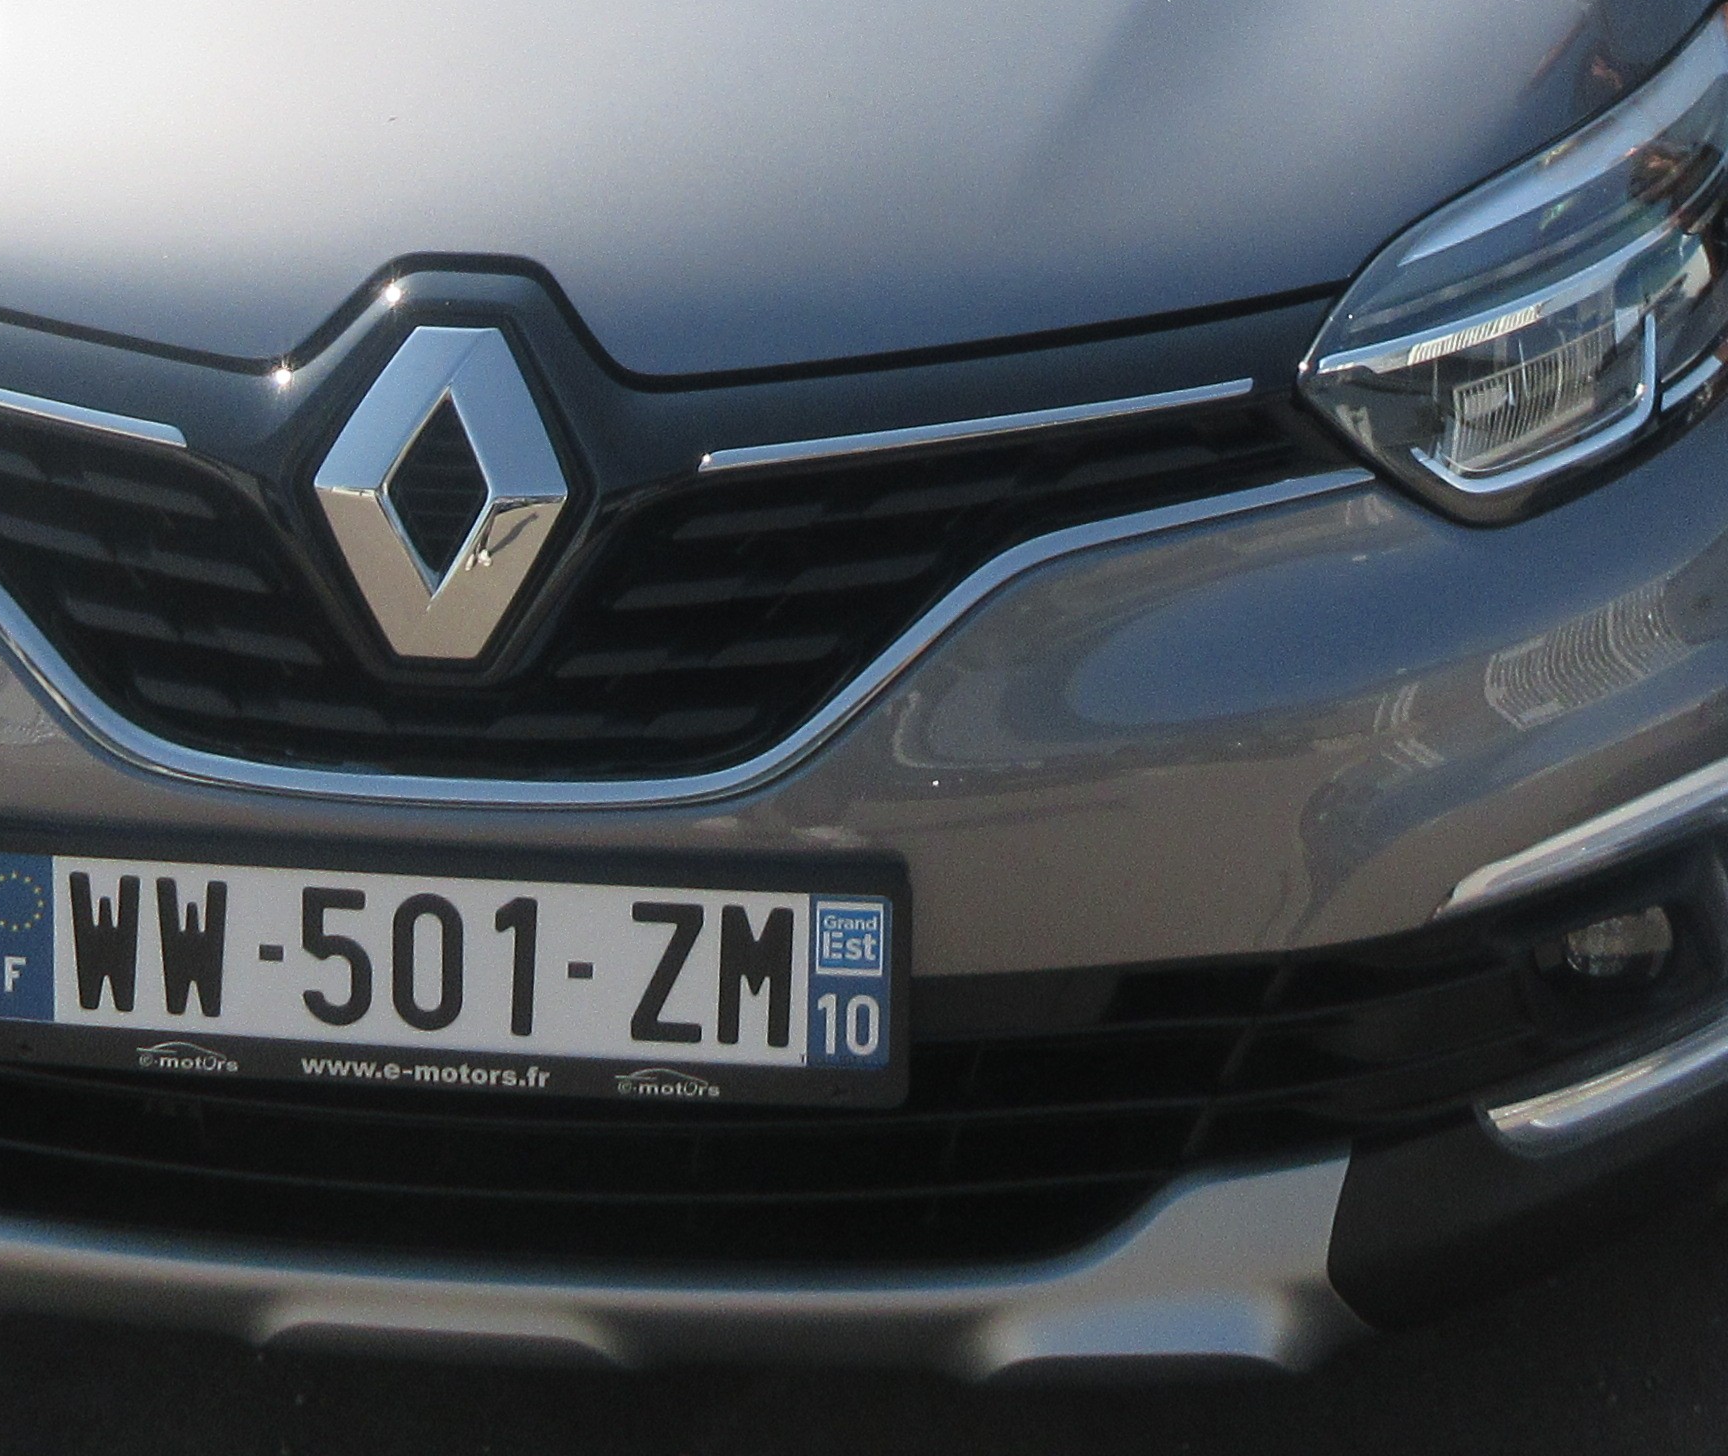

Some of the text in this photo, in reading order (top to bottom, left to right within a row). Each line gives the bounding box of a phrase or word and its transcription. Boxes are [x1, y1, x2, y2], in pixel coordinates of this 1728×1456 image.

[822, 913, 877, 932] Grand
[822, 932, 877, 962] Est
[3, 955, 28, 993] F
[817, 992, 880, 1056] 10
[300, 1055, 551, 1090] www.e-motors.fr
